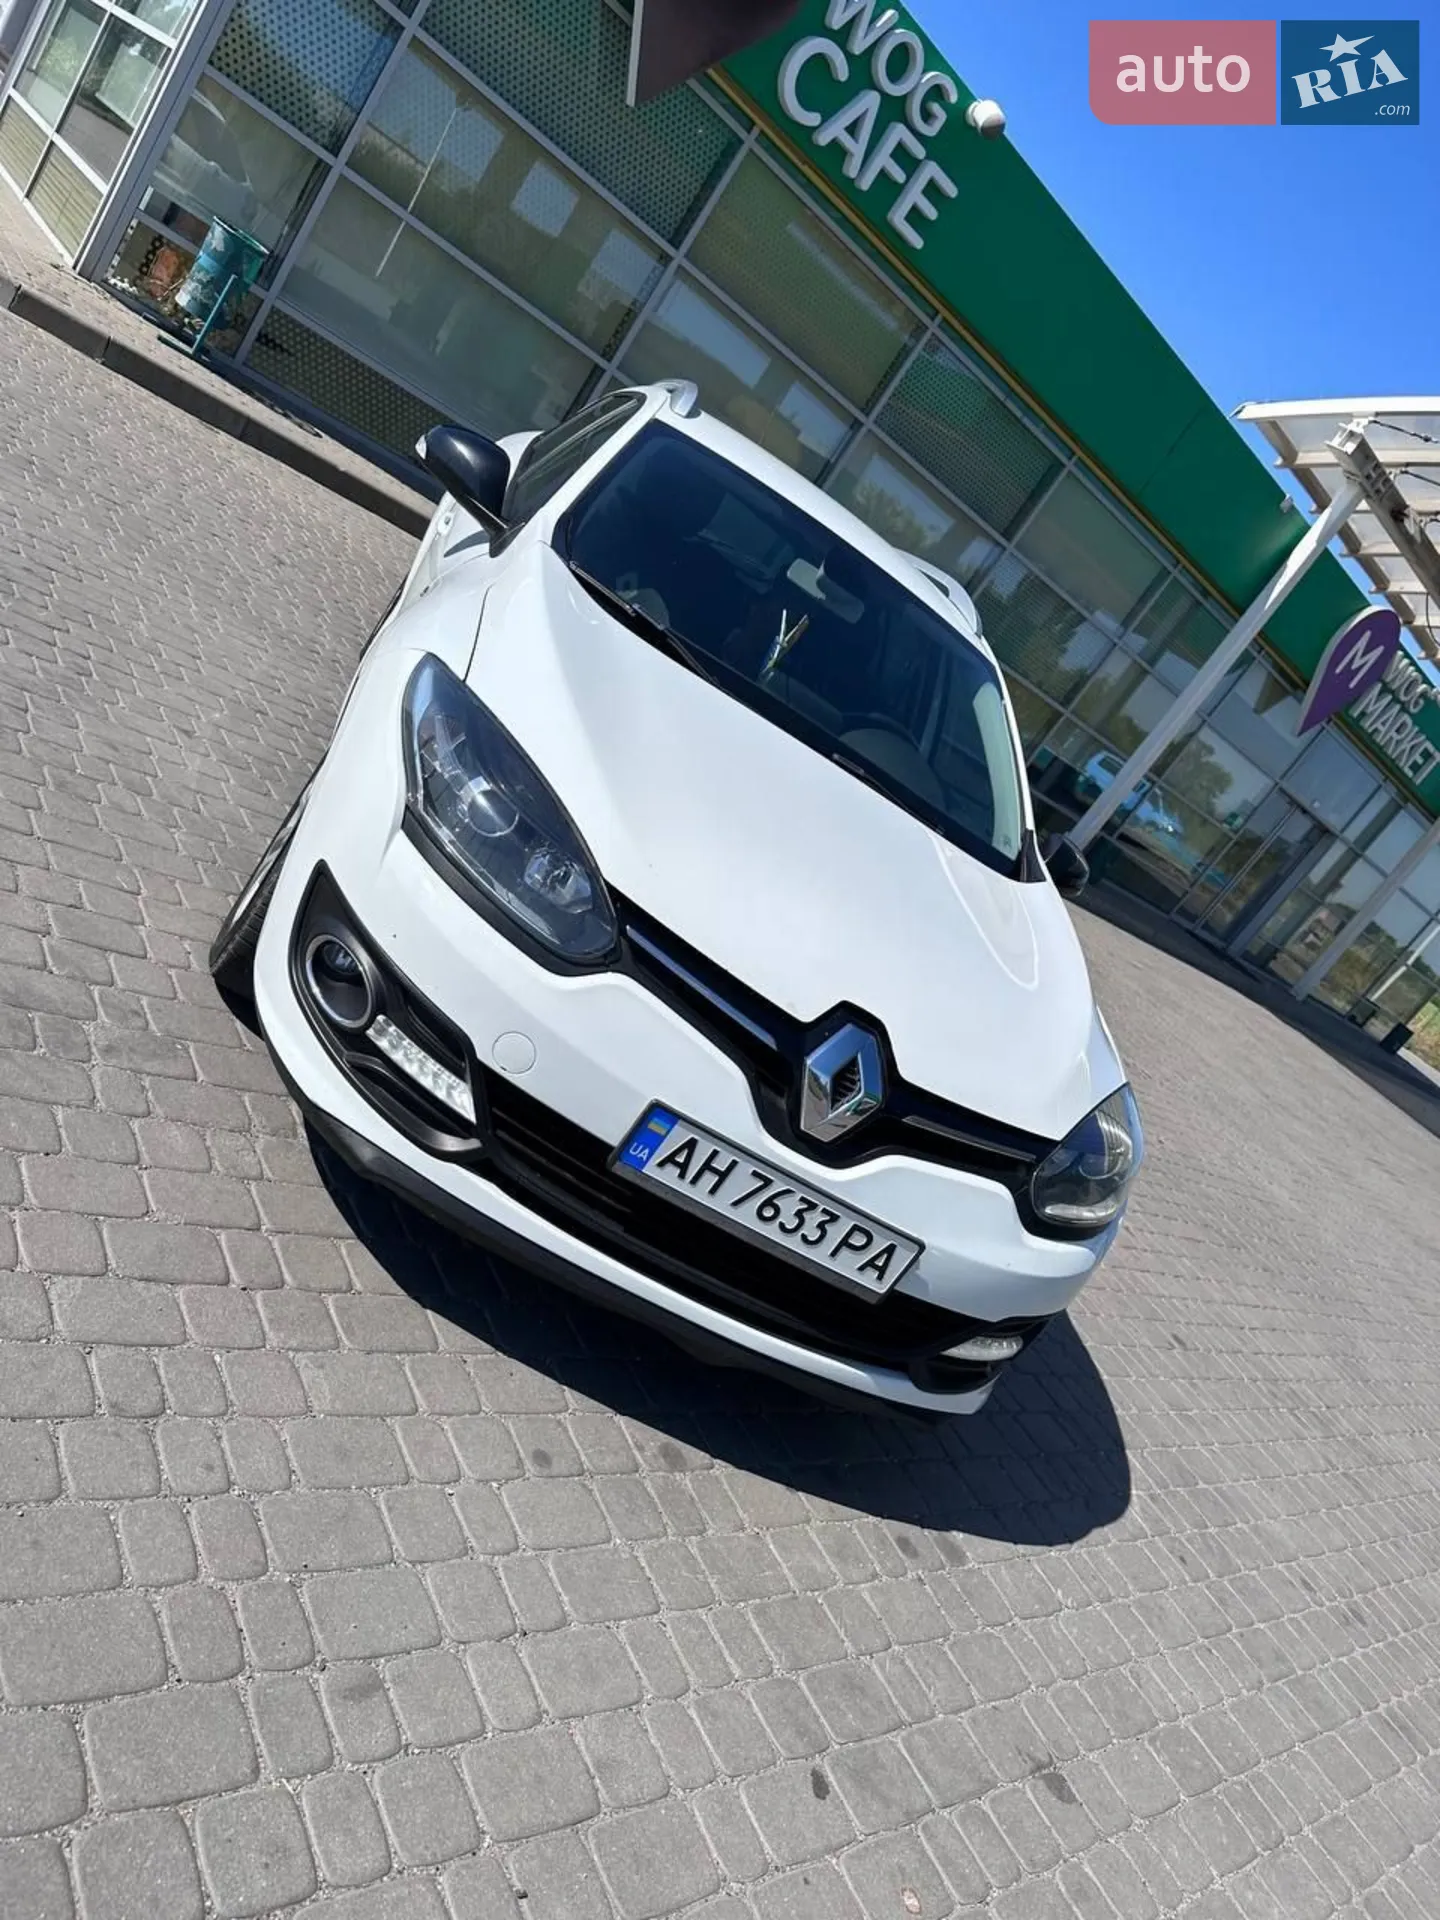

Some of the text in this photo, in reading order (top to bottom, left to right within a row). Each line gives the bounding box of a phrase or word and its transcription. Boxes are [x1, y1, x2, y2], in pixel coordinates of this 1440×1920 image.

[824, 0, 958, 136] WOG
[777, 36, 958, 249] CAFE
[1335, 630, 1385, 689] M
[1348, 682, 1440, 786] MARKET
[629, 1142, 650, 1162] UA
[656, 1135, 898, 1283] AH 7633 PA
